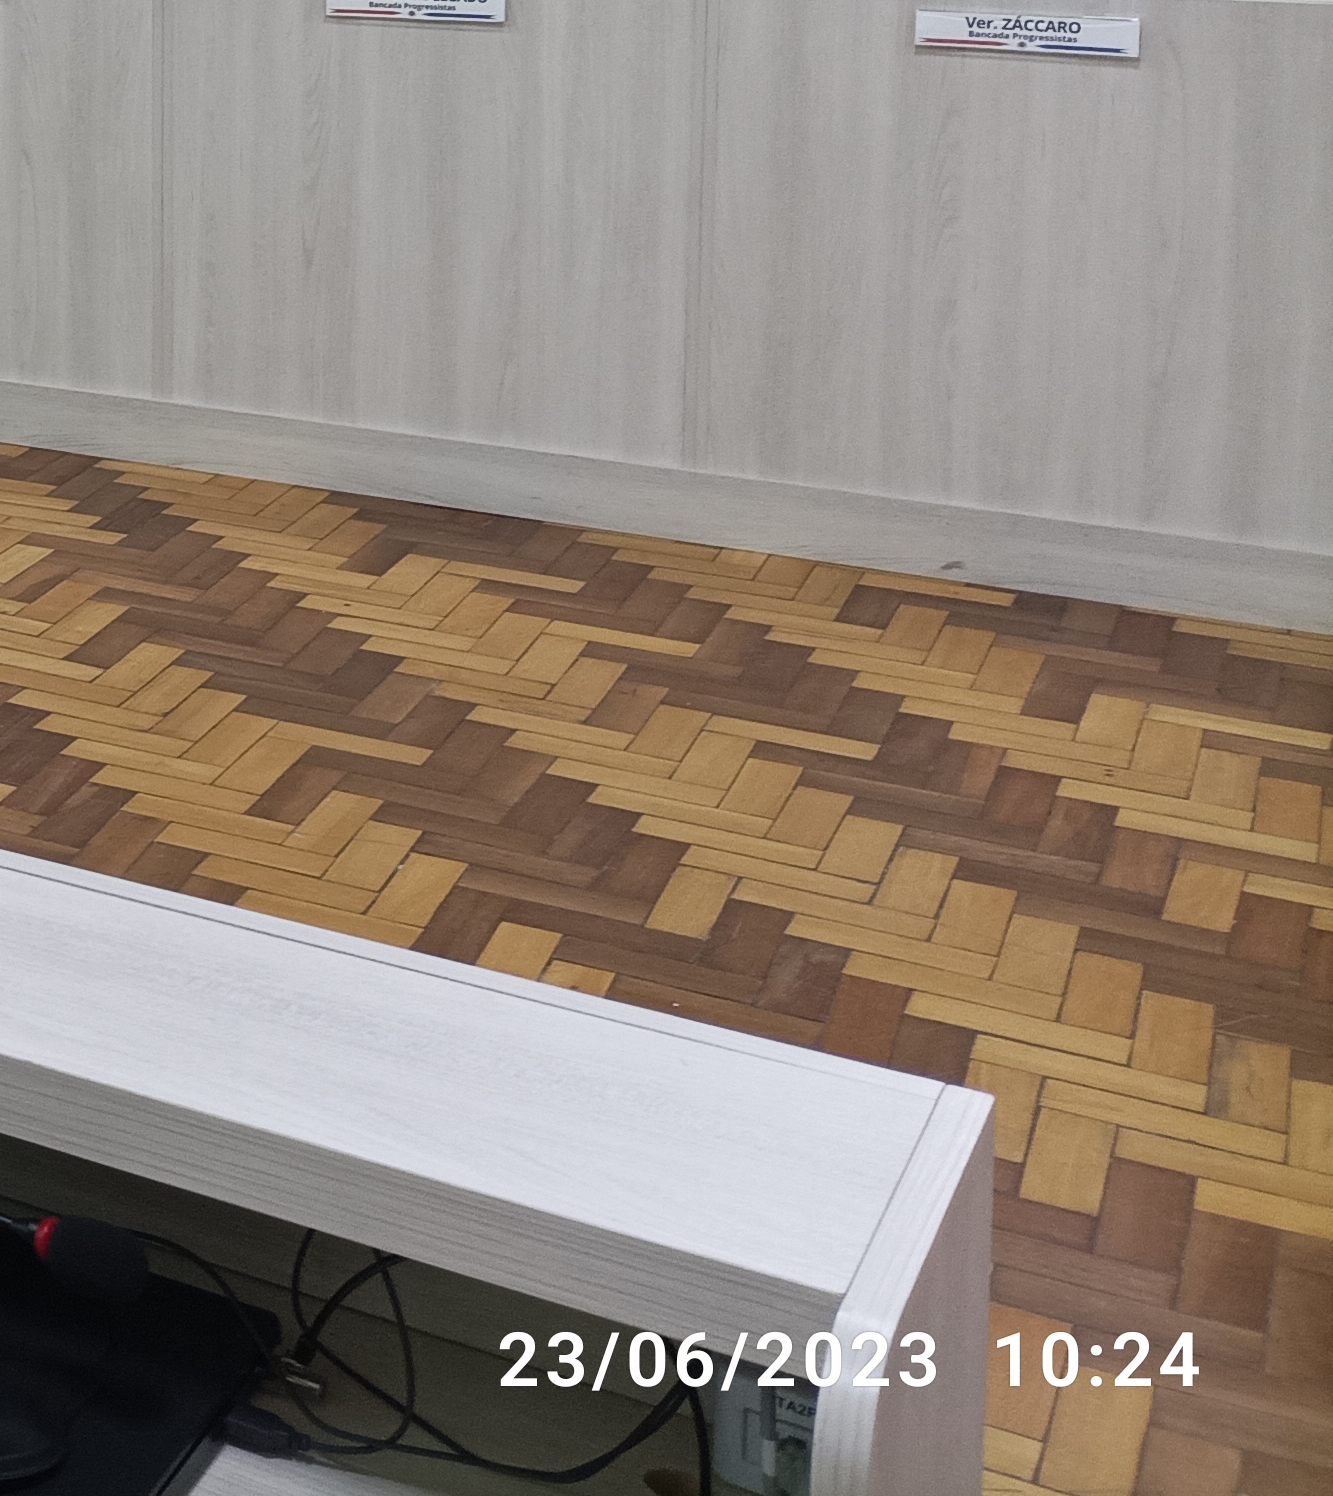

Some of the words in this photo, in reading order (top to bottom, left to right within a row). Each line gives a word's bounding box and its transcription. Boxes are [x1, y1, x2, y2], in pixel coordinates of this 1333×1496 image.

[369, 1, 402, 9] Bancada
[404, 3, 456, 12] Progressistas
[965, 16, 998, 30] Ver.
[1001, 15, 1081, 34] ZÁCCARO
[968, 30, 1010, 40] Bancada
[1012, 32, 1078, 43] Progressistas
